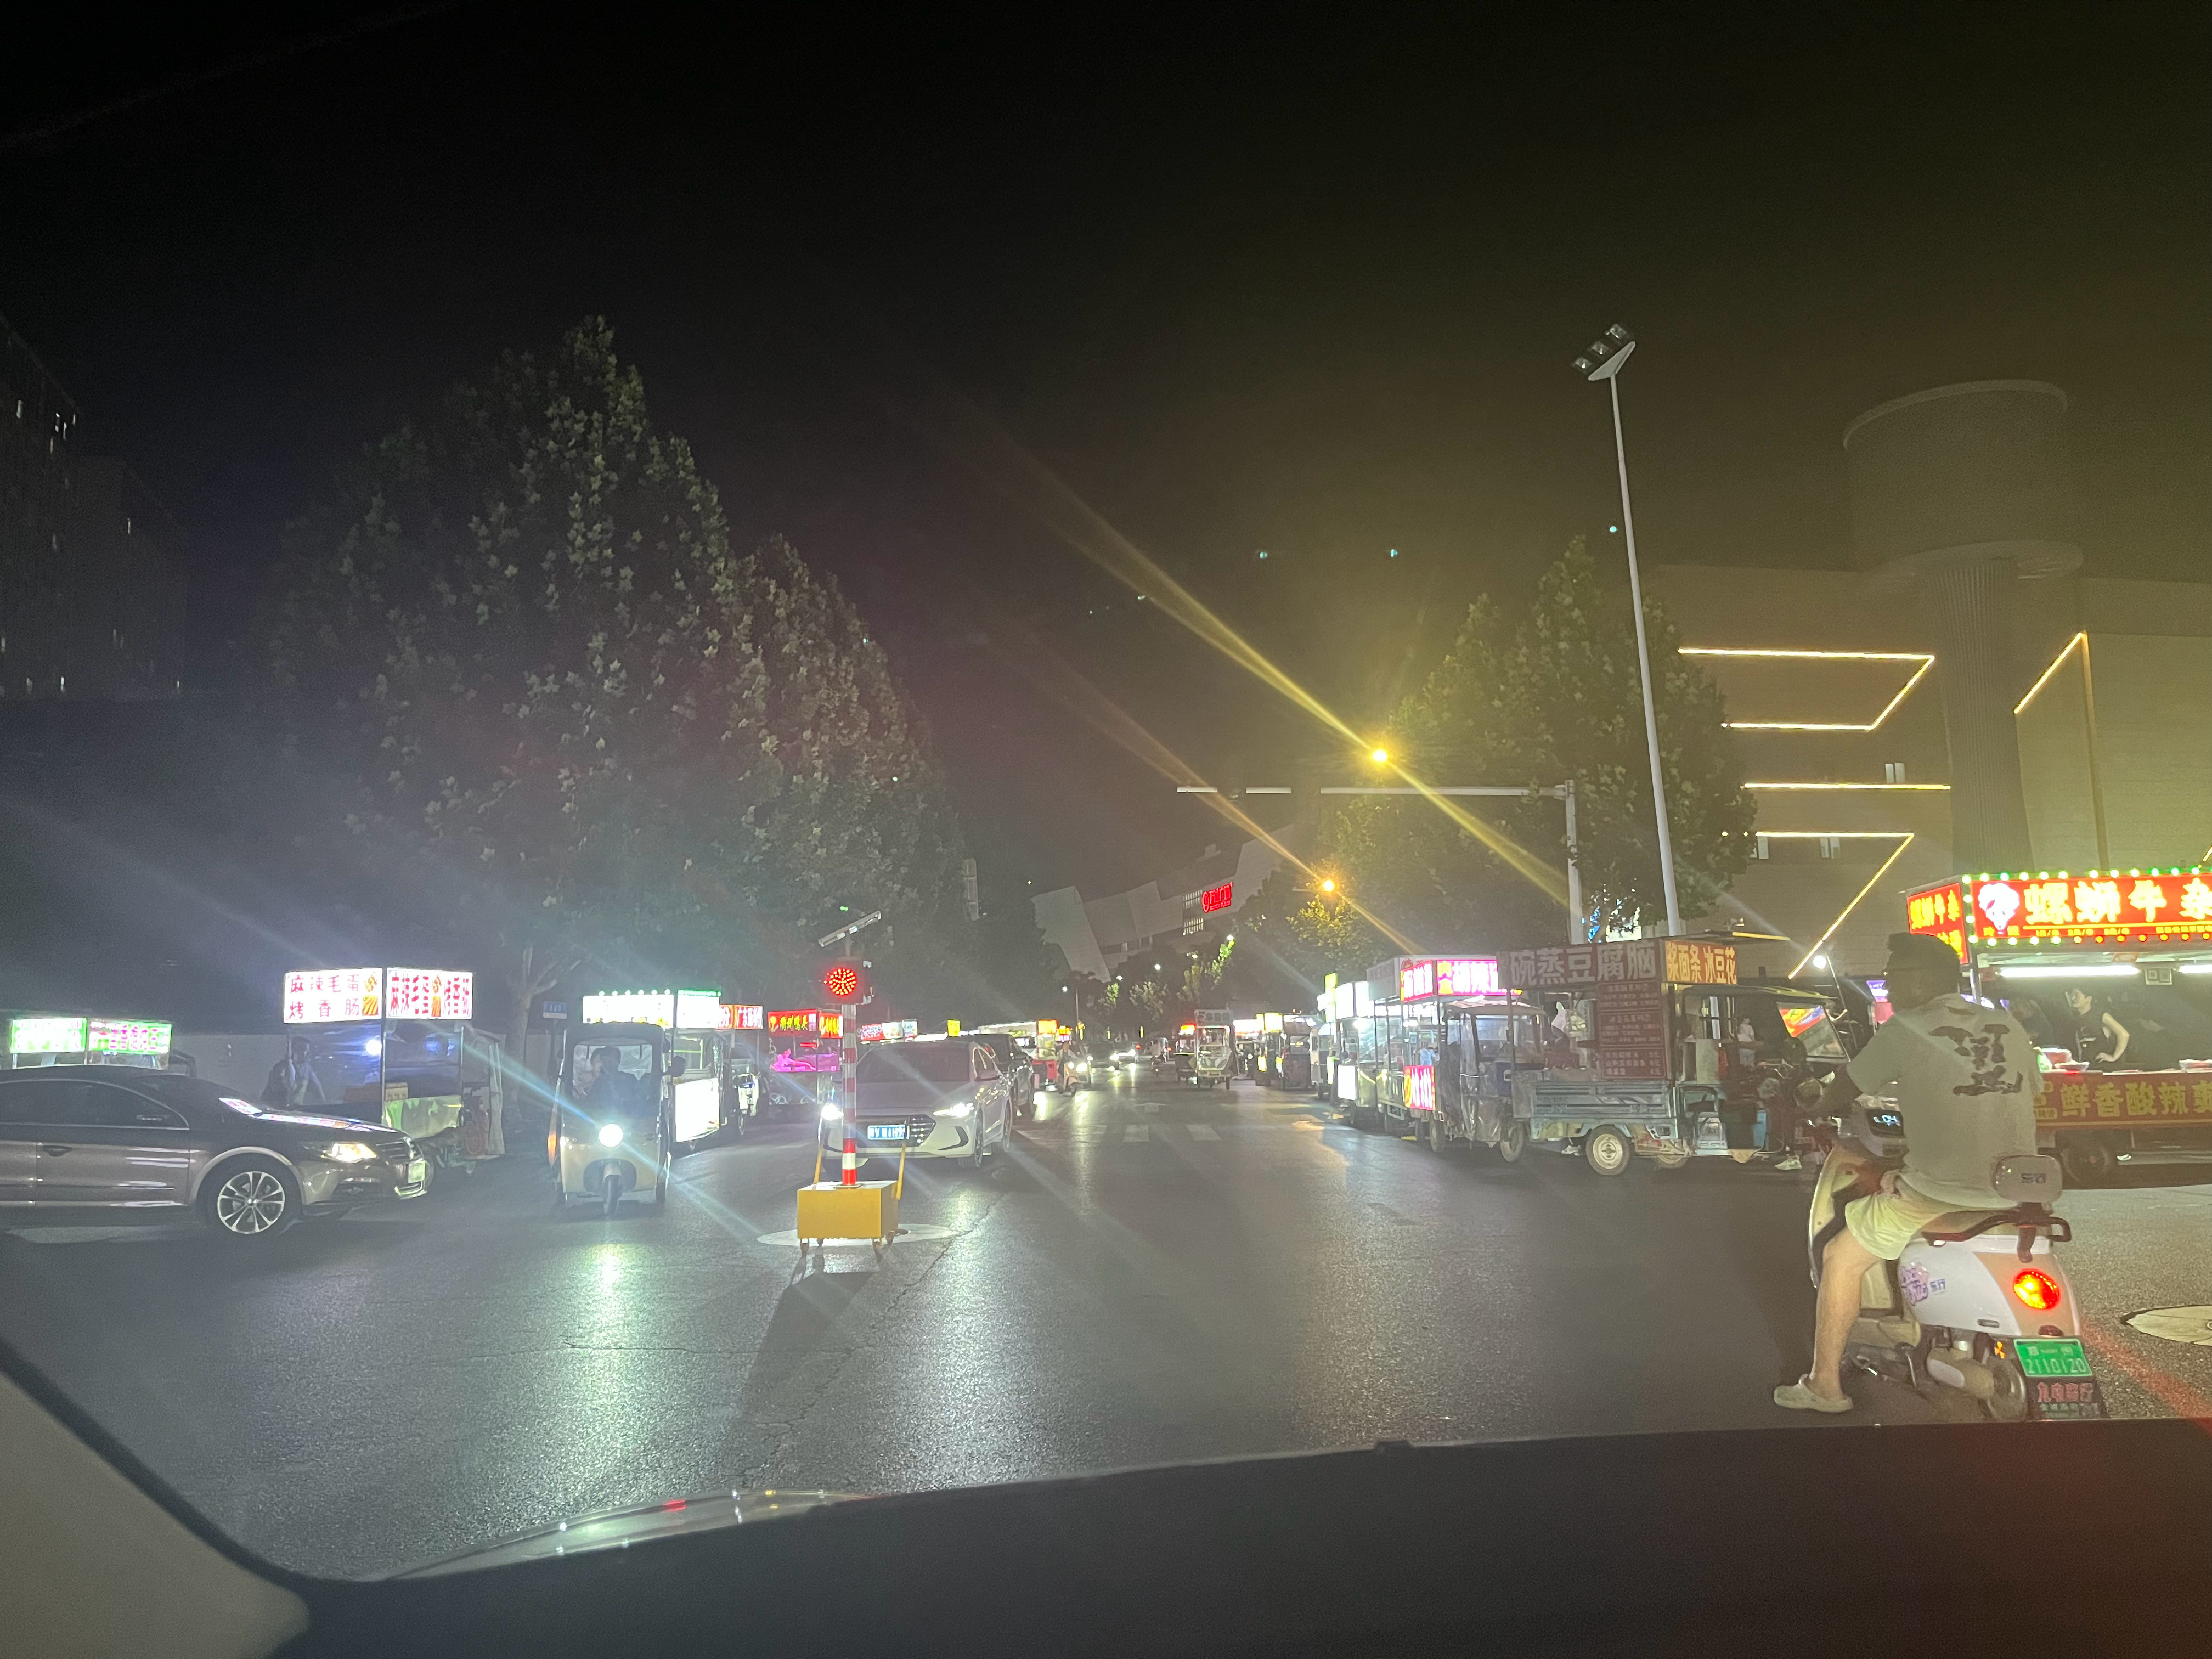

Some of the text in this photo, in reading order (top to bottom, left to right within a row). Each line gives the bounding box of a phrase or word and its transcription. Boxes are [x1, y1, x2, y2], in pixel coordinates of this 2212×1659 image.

[290, 974, 360, 994] 麻辣毛蛋
[390, 972, 470, 1016] 麻辣毛蛋 烤香肠
[289, 998, 360, 1020] 烤香肠
